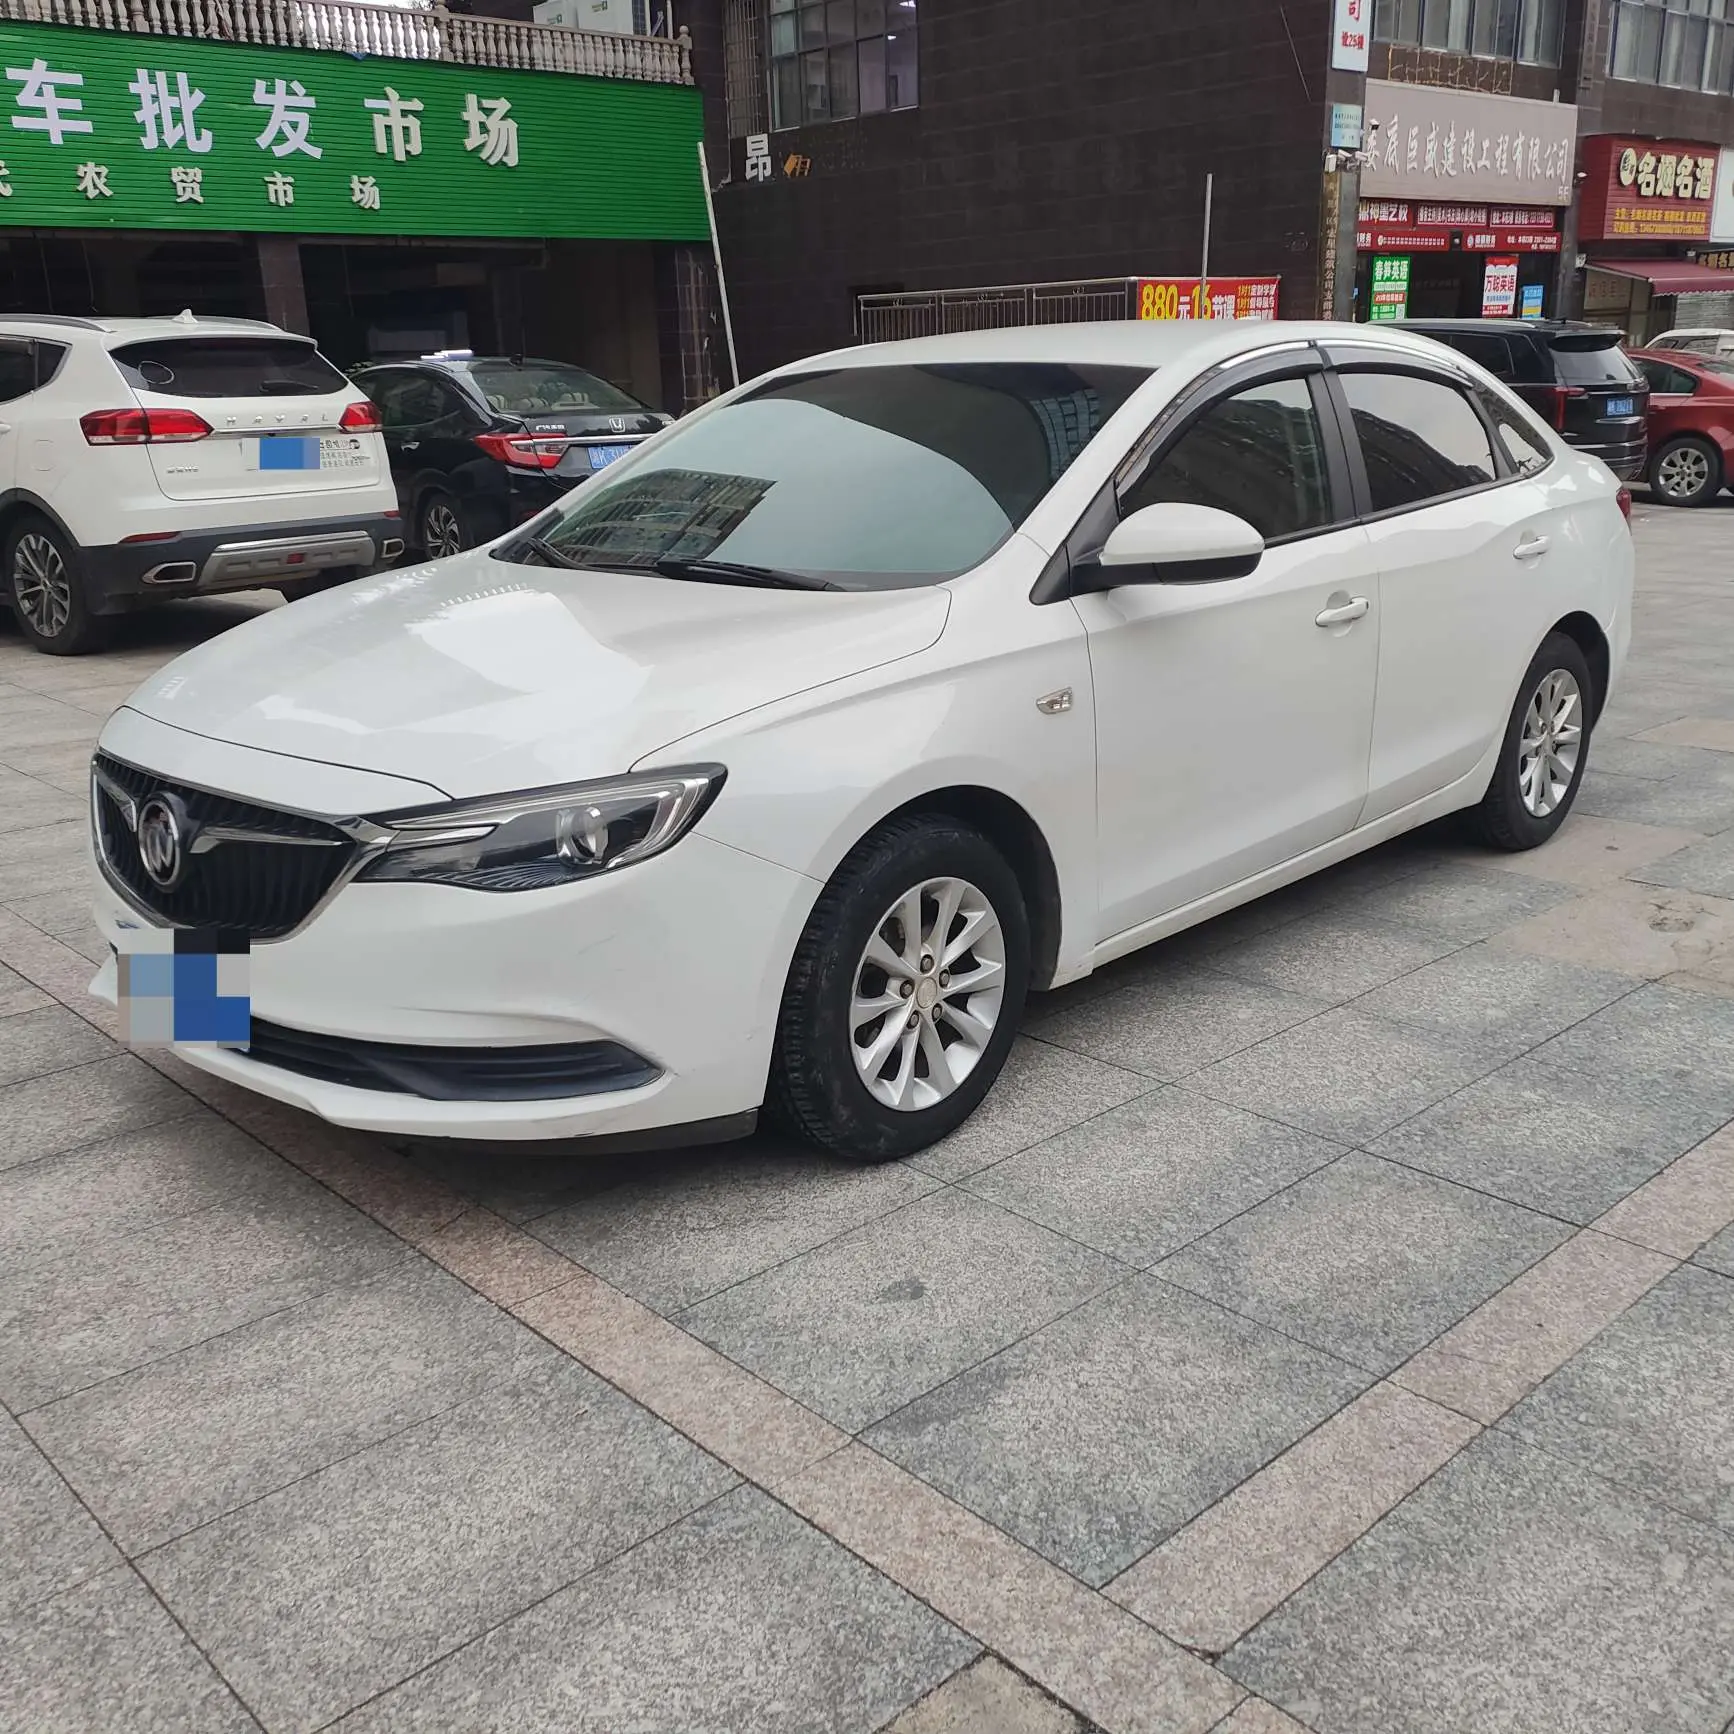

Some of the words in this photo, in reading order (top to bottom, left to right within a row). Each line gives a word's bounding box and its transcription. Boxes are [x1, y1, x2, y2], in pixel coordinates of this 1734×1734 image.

[5, 57, 520, 168] 车批发市场
[745, 133, 772, 182] 昂
[1637, 151, 1715, 199] 名烟名酒
